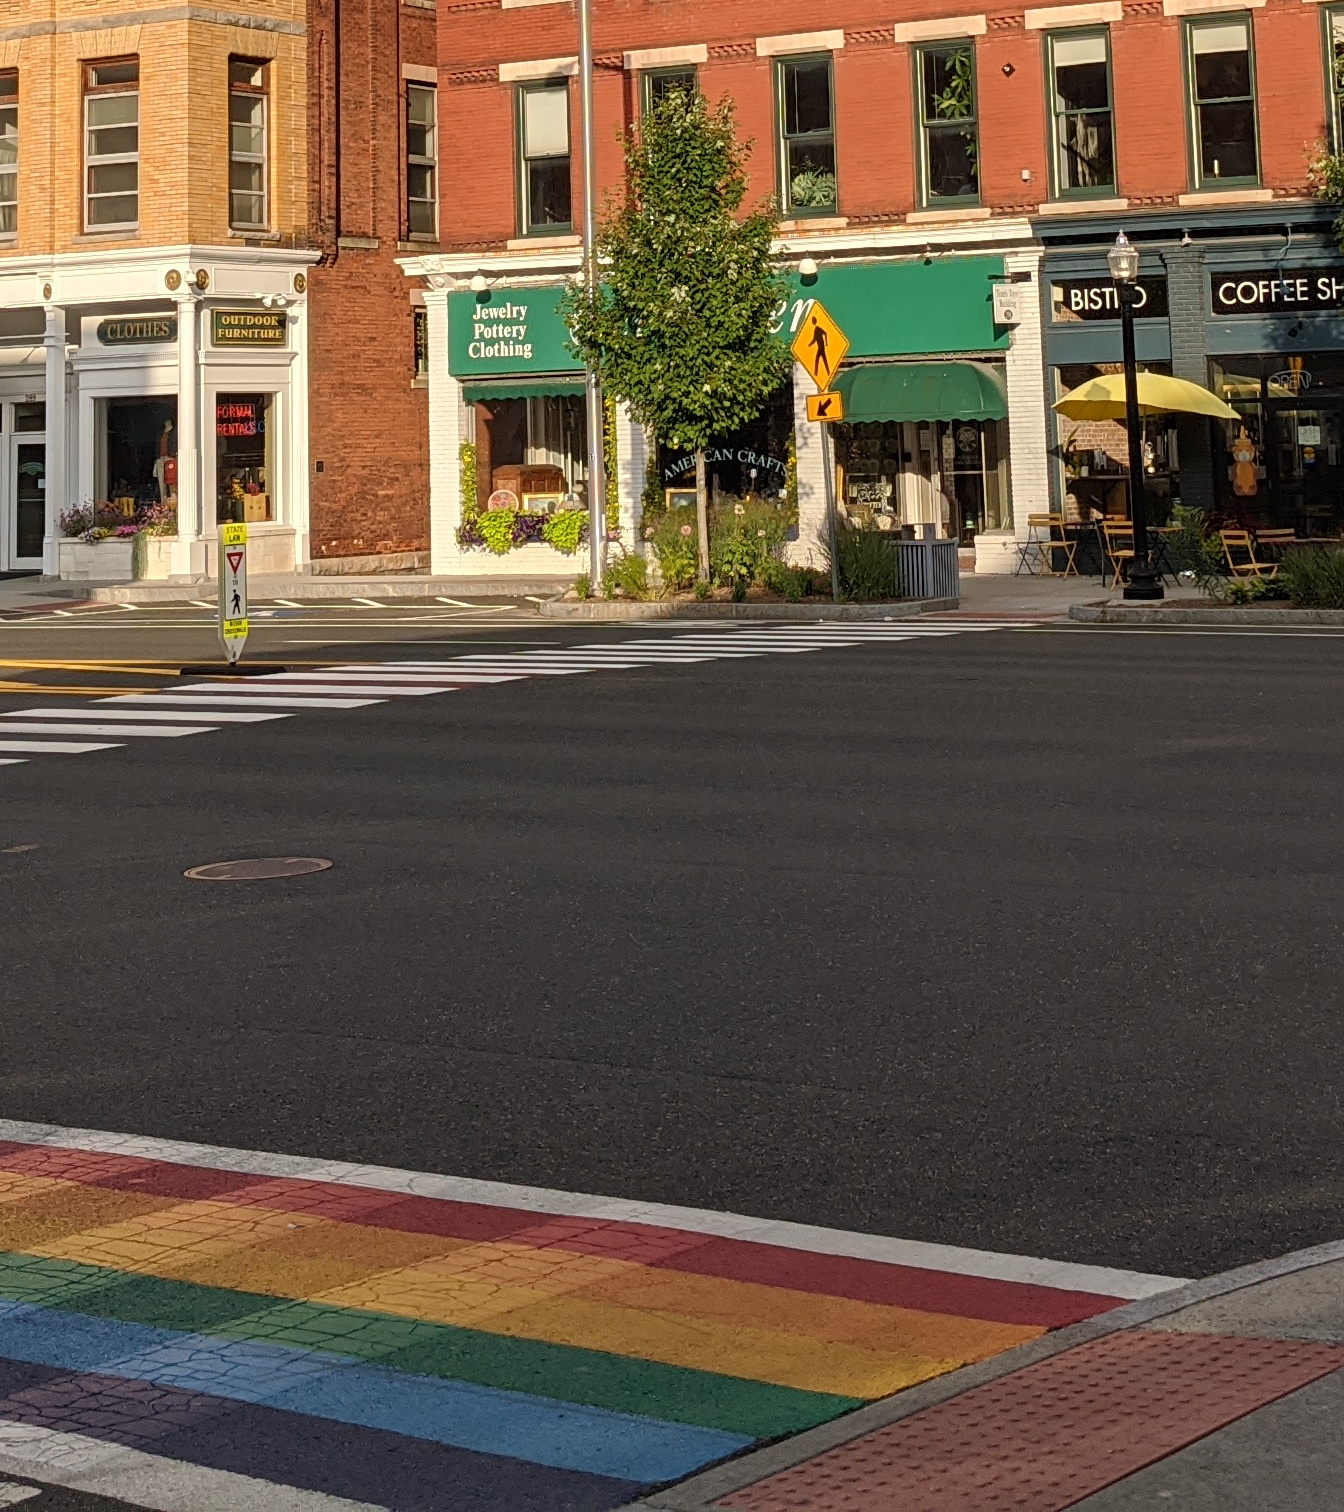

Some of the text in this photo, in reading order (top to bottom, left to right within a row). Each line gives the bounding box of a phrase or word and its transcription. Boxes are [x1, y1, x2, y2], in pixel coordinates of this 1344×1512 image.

[1070, 285, 1147, 311] BISTO
[1219, 279, 1308, 305] COFFEE
[472, 302, 528, 321] Jewelry
[221, 315, 279, 326] OUTDOOR
[107, 321, 170, 339] CLOTHES
[217, 328, 283, 339] FURNITURE
[473, 323, 527, 340] Pottery
[468, 340, 533, 359] Clothing
[1269, 373, 1310, 390] OPEN
[217, 405, 254, 418] FORMAL
[664, 448, 788, 481] AMERCAN CRAFTS
[226, 525, 244, 534] STATE
[228, 534, 241, 542] LAW
